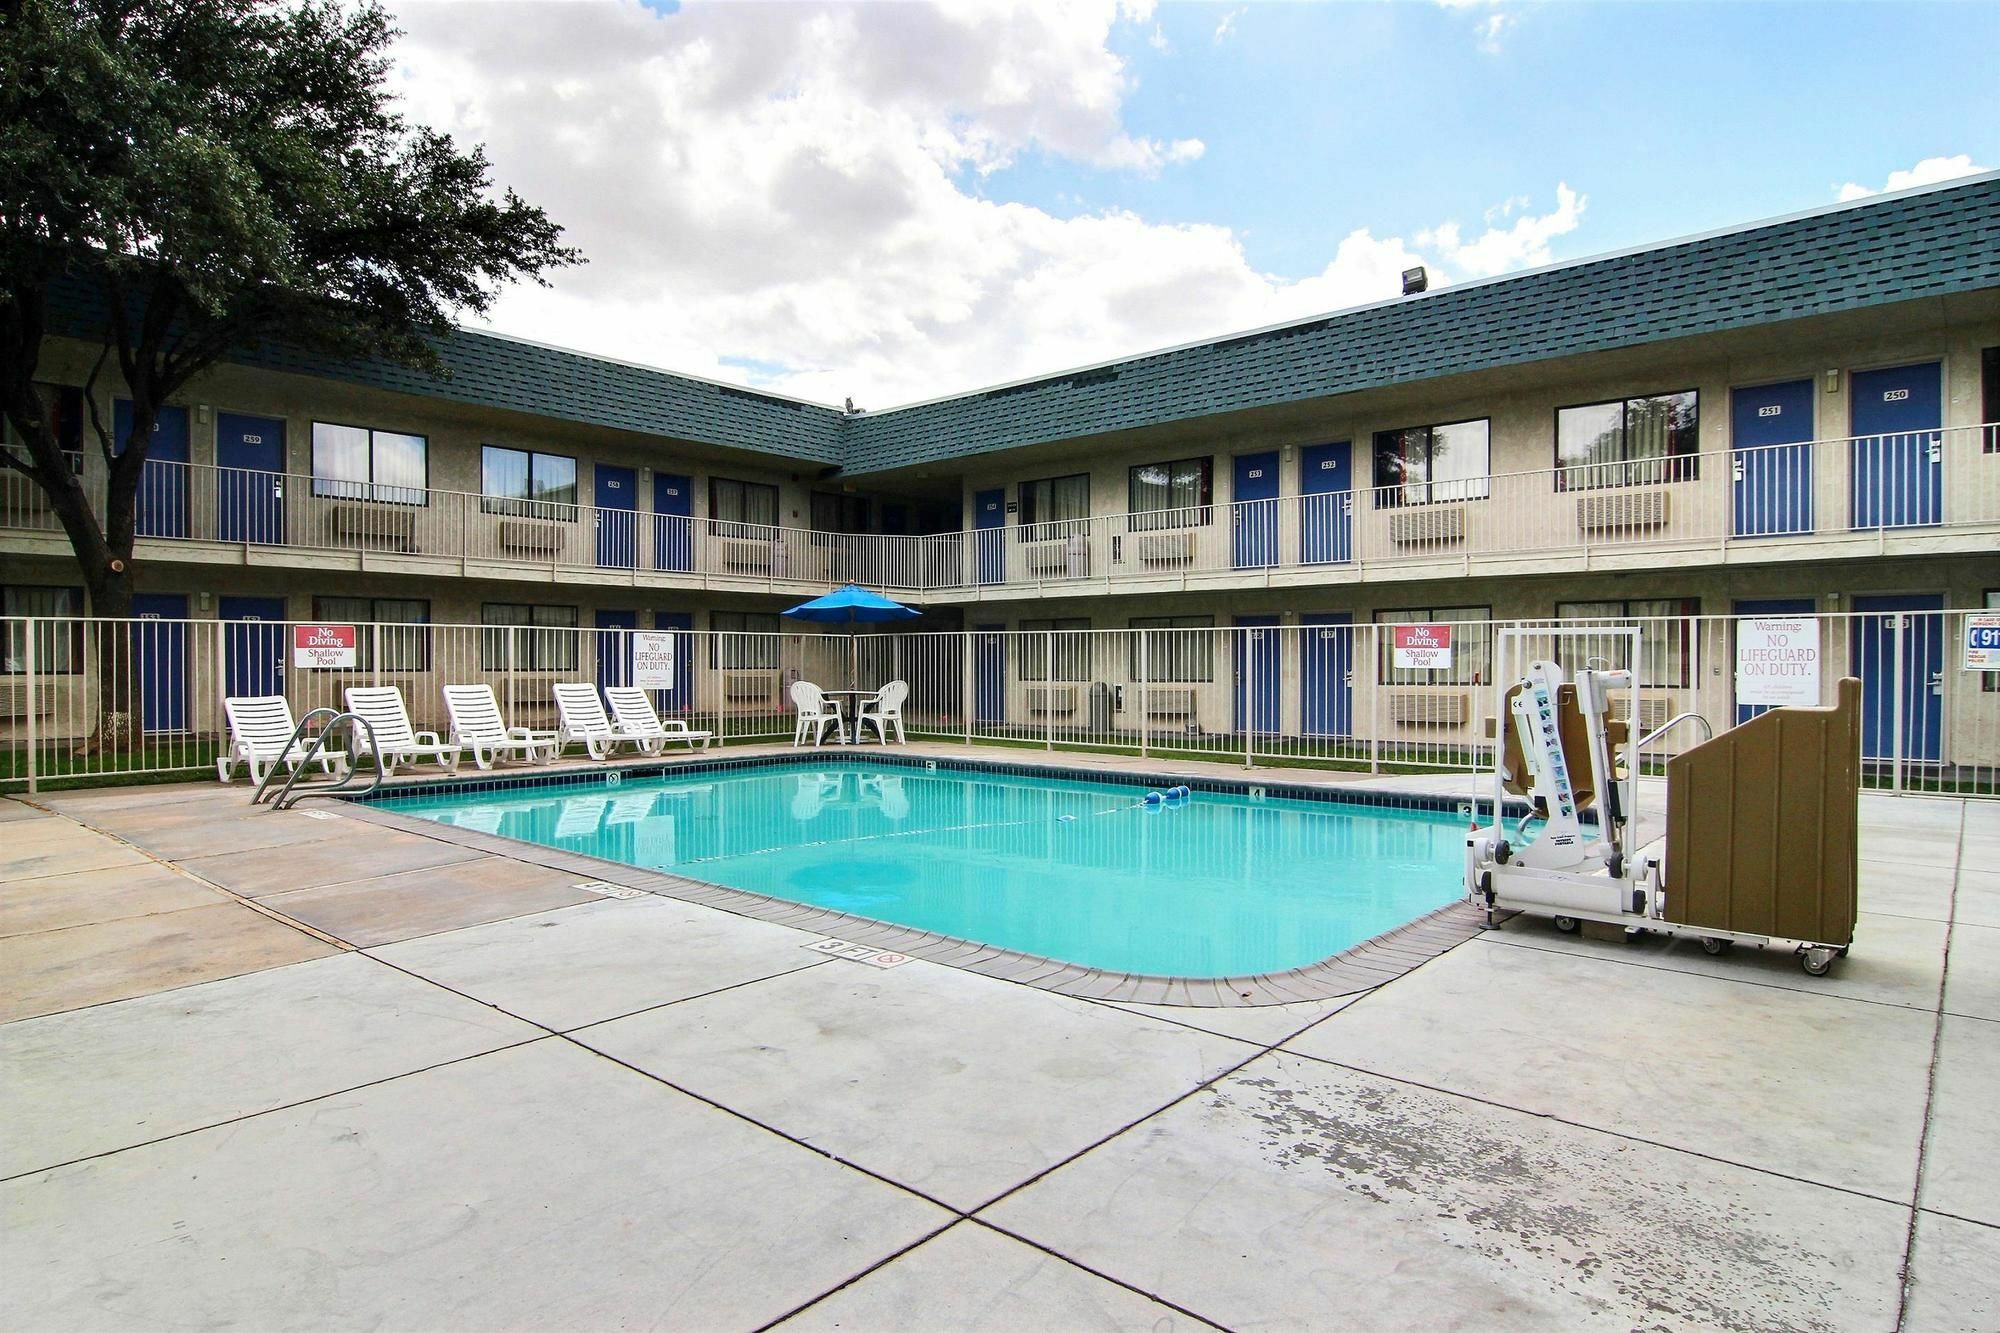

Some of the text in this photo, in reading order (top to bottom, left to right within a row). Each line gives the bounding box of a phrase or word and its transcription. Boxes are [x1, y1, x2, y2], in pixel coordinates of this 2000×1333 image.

[1886, 390, 1907, 400] 250
[1761, 407, 1779, 416] 251
[1754, 622, 1802, 633] Warning:
[318, 628, 334, 637] No
[1415, 628, 1430, 637] No
[309, 636, 344, 648] Diving
[1767, 634, 1789, 647] NO
[1981, 629, 2000, 646] 91
[648, 643, 660, 651] NO
[1407, 637, 1439, 648] Diving
[308, 649, 344, 657] Shallow
[635, 652, 673, 661] LIFEGUARD
[1405, 649, 1439, 658] Shallow
[1740, 648, 1816, 662] LIFEGUARD
[317, 657, 336, 665] Pool
[1413, 658, 1431, 666] Pool
[637, 662, 671, 671] ON DUTY.
[1744, 663, 1812, 676] ON DUTY.
[818, 941, 880, 958] 3 FT
